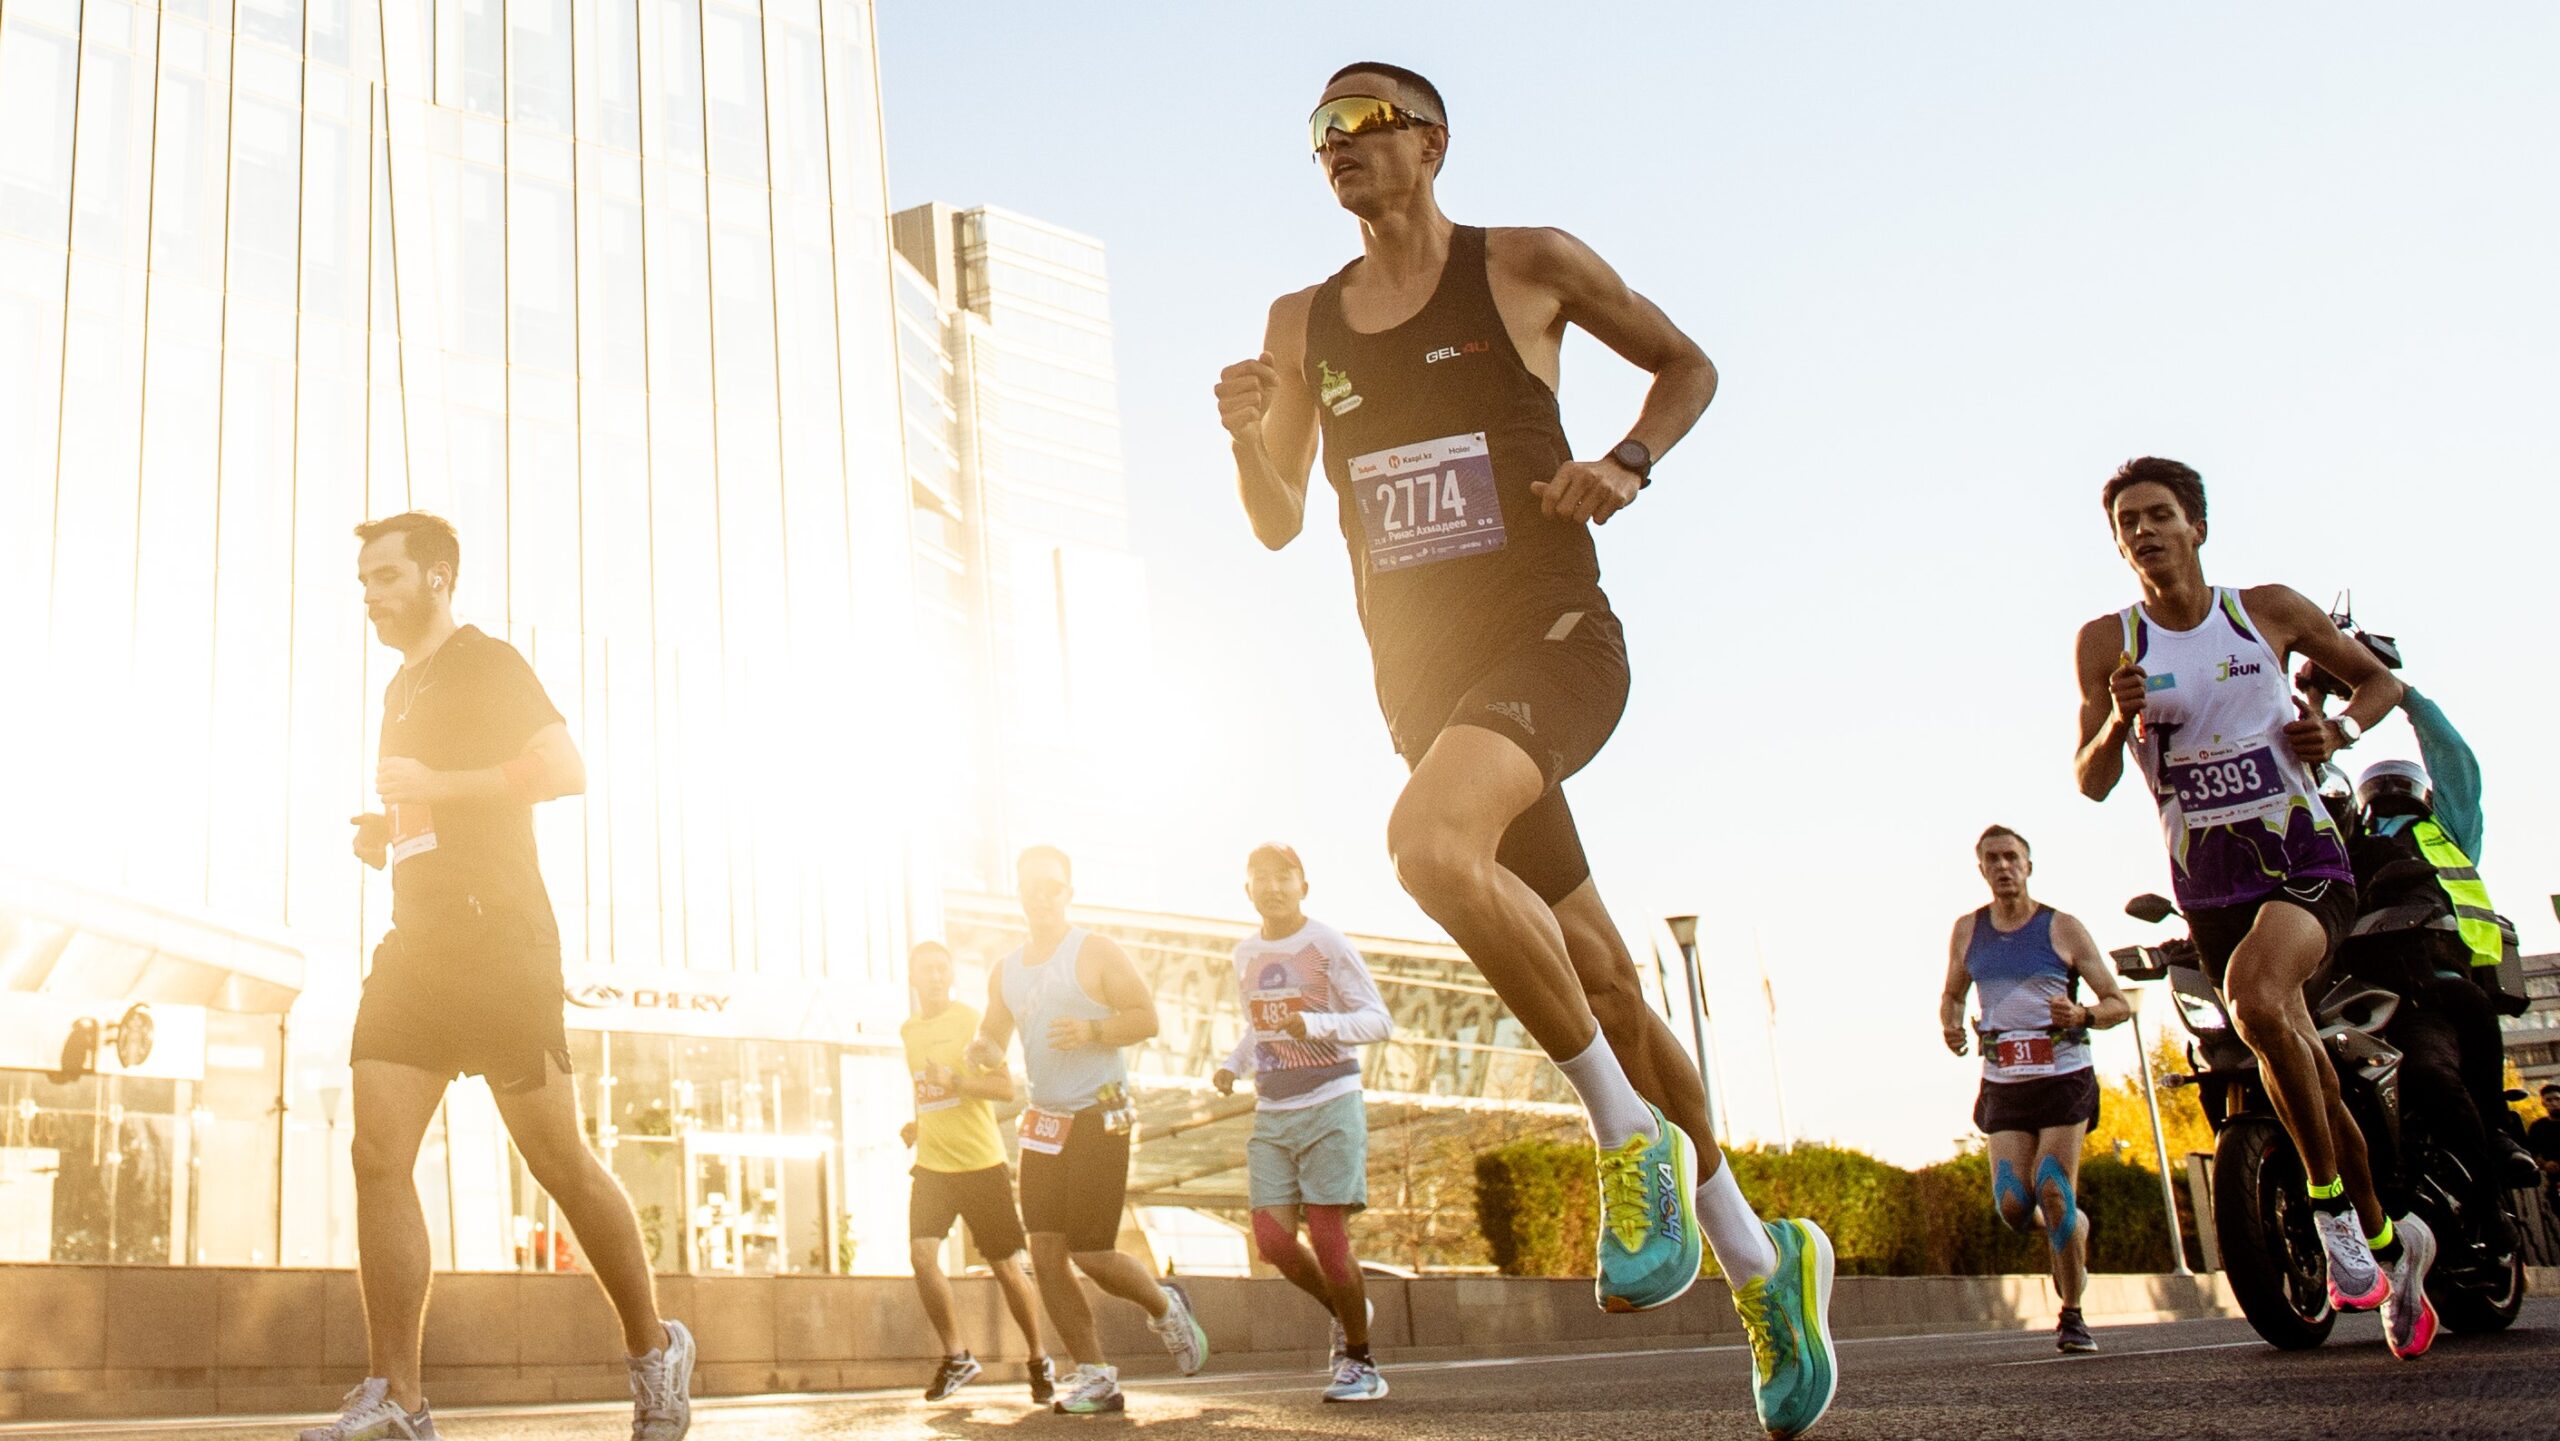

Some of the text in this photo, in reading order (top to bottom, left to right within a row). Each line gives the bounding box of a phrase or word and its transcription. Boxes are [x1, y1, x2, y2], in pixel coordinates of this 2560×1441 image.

[1426, 346, 1461, 363] GEL
[1376, 469, 1467, 531] 2774
[1417, 520, 1467, 537] Ахмадеев
[2190, 758, 2262, 800] 3393
[1263, 1002, 1290, 1024] 483
[2014, 1041, 2033, 1060] 31
[1658, 1163, 1683, 1244] HOKA
